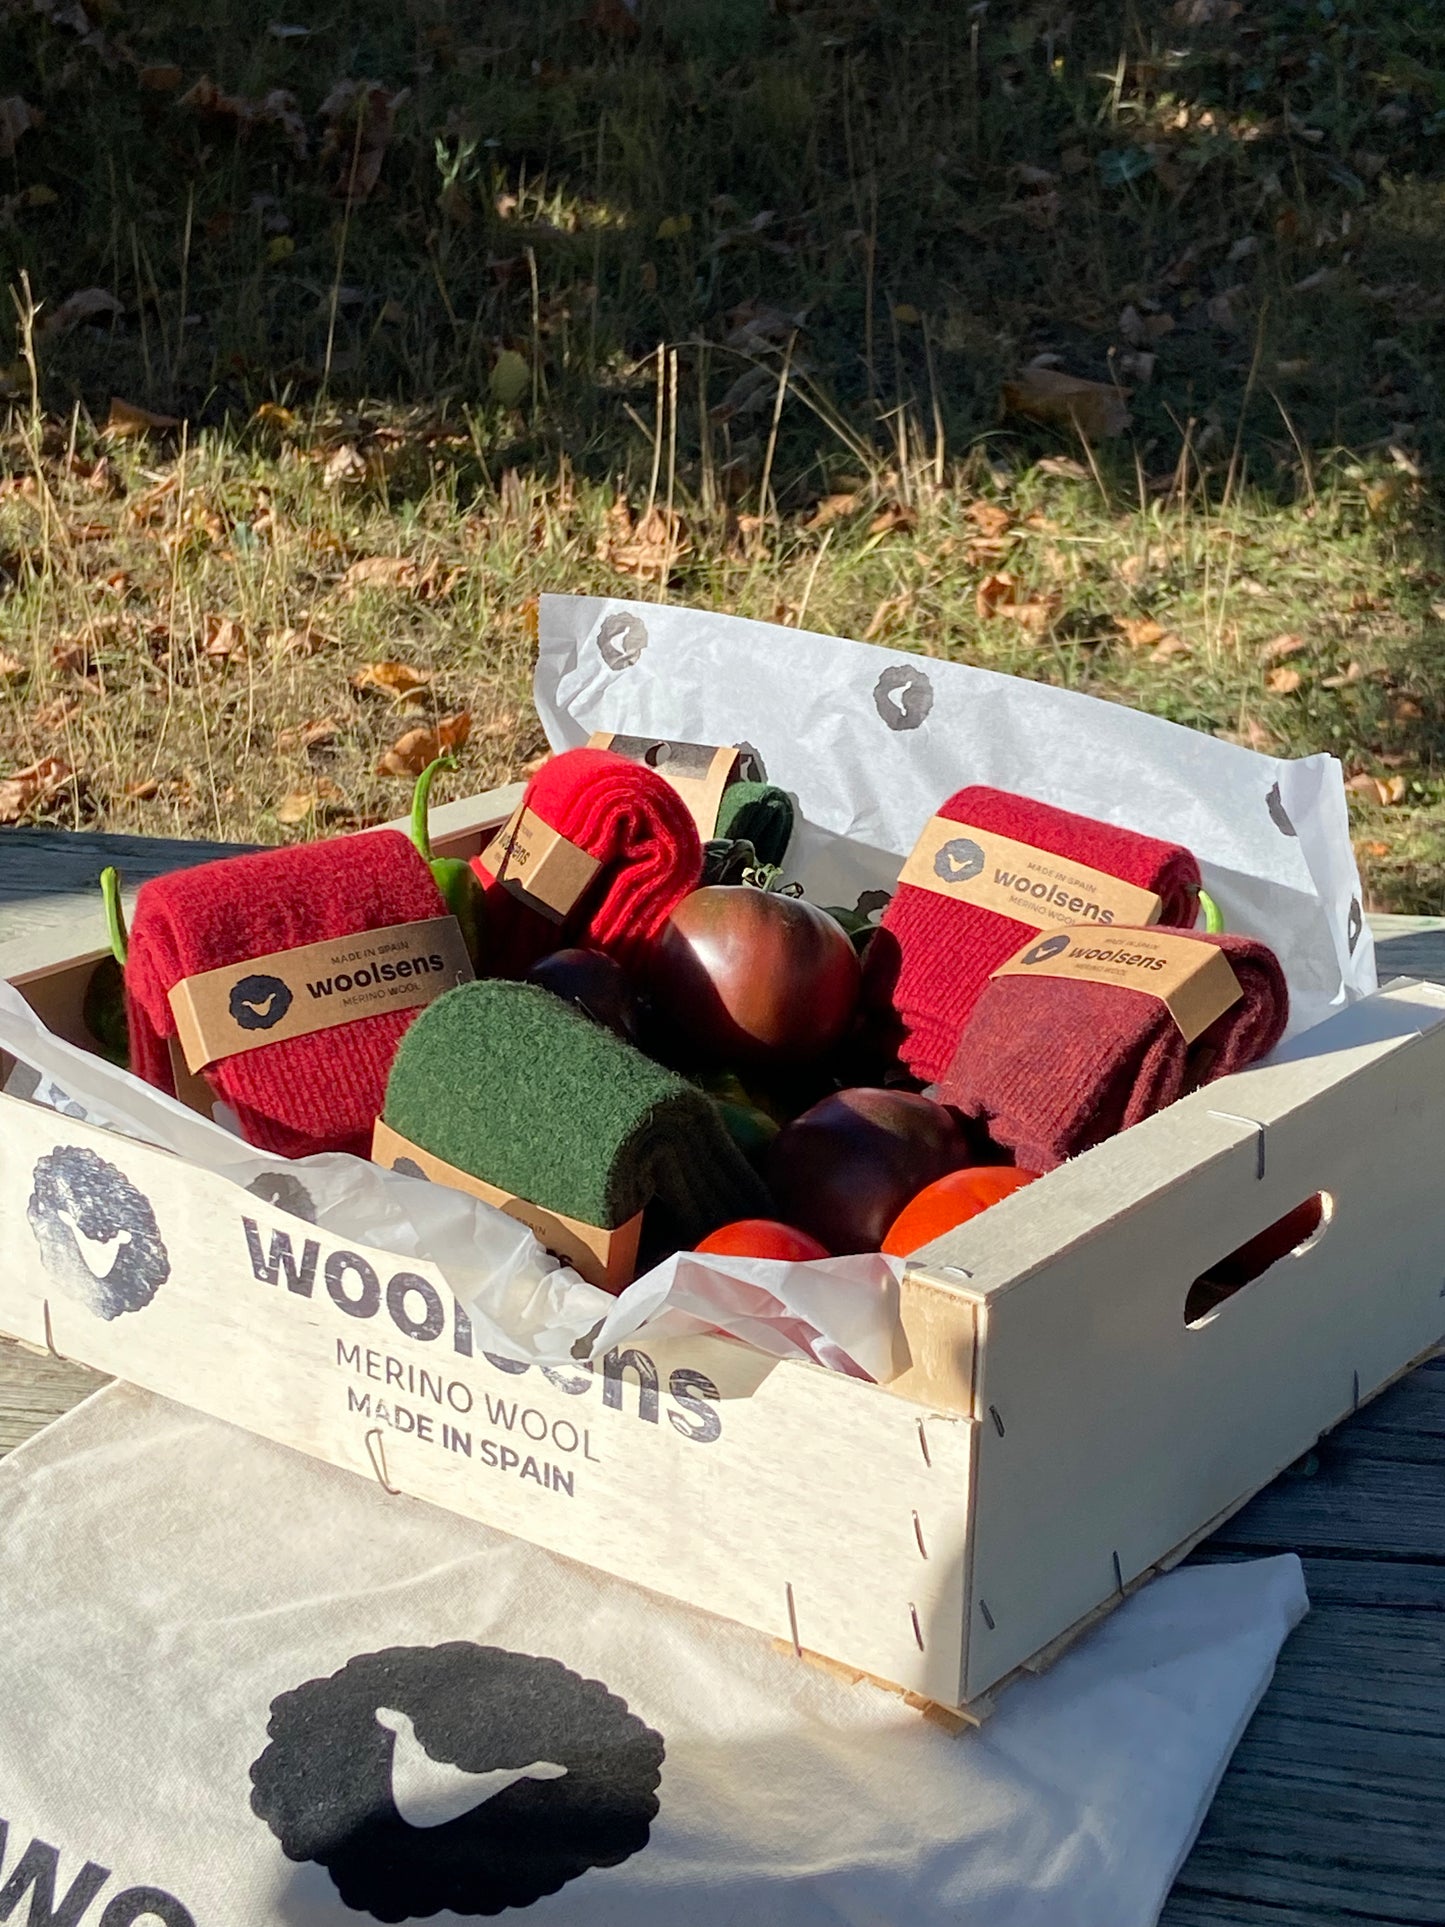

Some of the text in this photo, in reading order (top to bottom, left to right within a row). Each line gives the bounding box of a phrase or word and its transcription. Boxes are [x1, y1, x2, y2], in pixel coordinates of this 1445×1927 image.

[1026, 861, 1097, 894] MADE IN SPAIN
[993, 867, 1115, 925] woolsens
[1008, 894, 1047, 915] MERINO
[330, 940, 410, 966] MADE IN SPAIN
[1068, 947, 1167, 971] woolsens
[305, 953, 445, 999] woolsens
[342, 981, 423, 1008] MERINO WOOL
[335, 1337, 602, 1465] MERINO WOOL
[347, 1386, 575, 1498] MADE IN SPAIN
